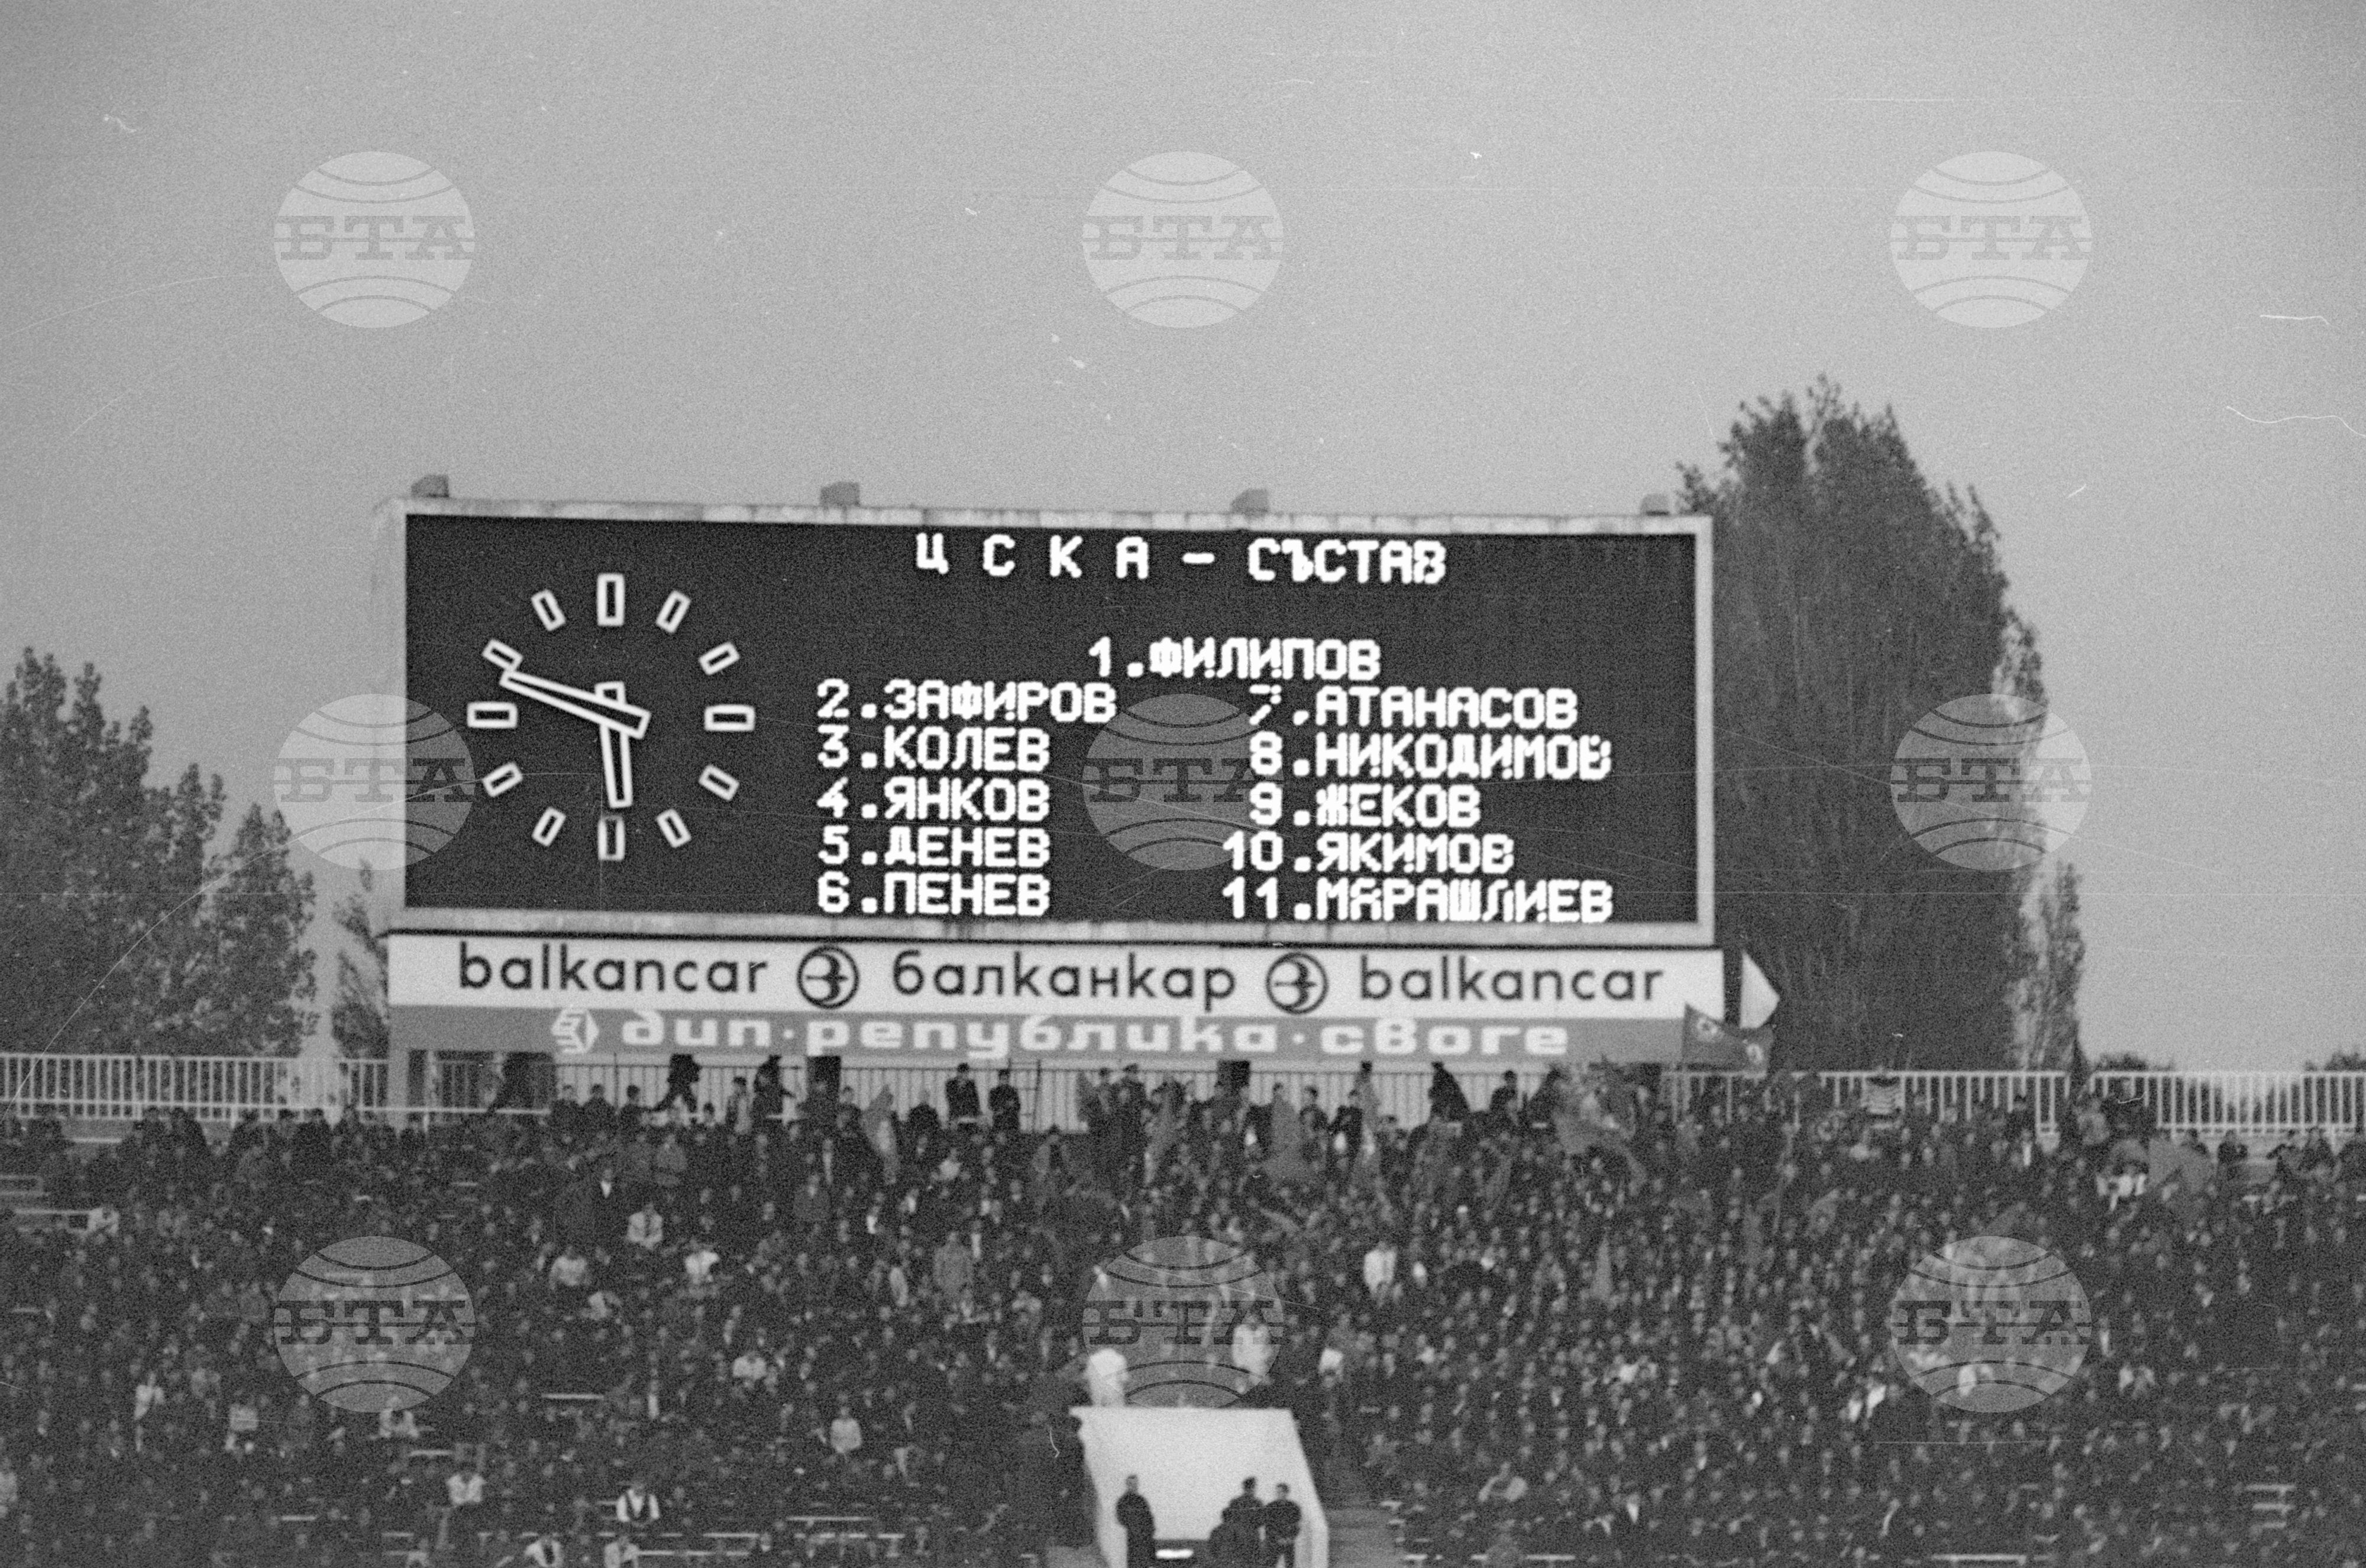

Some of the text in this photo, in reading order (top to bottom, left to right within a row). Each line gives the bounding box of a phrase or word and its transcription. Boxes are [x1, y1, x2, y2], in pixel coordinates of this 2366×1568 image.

[1249, 539, 1445, 583] СЪСТАВ
[460, 941, 769, 992] balkancar
[893, 949, 1234, 1011] балканкар
[1362, 956, 1661, 1000] balkancar
